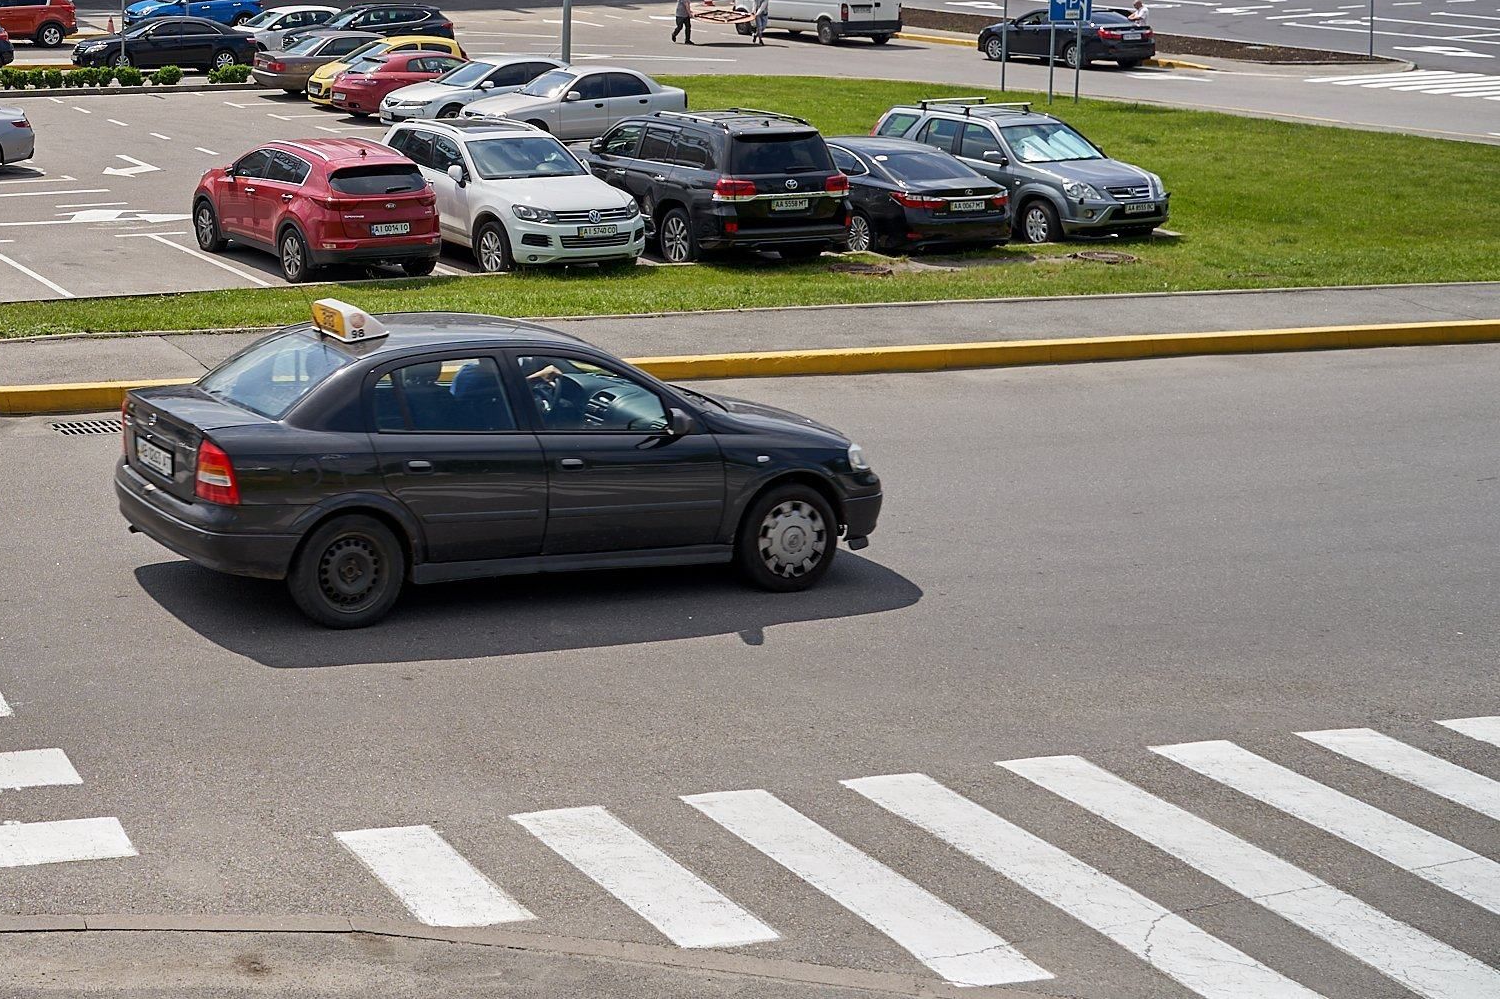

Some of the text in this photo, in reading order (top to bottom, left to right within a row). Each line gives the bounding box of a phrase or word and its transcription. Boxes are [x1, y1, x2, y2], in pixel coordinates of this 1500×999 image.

[775, 200, 784, 208] AA
[953, 202, 962, 210] AA
[374, 225, 383, 233] AI
[385, 224, 399, 232] 0014
[607, 226, 616, 234] CO
[351, 329, 365, 339] 98
